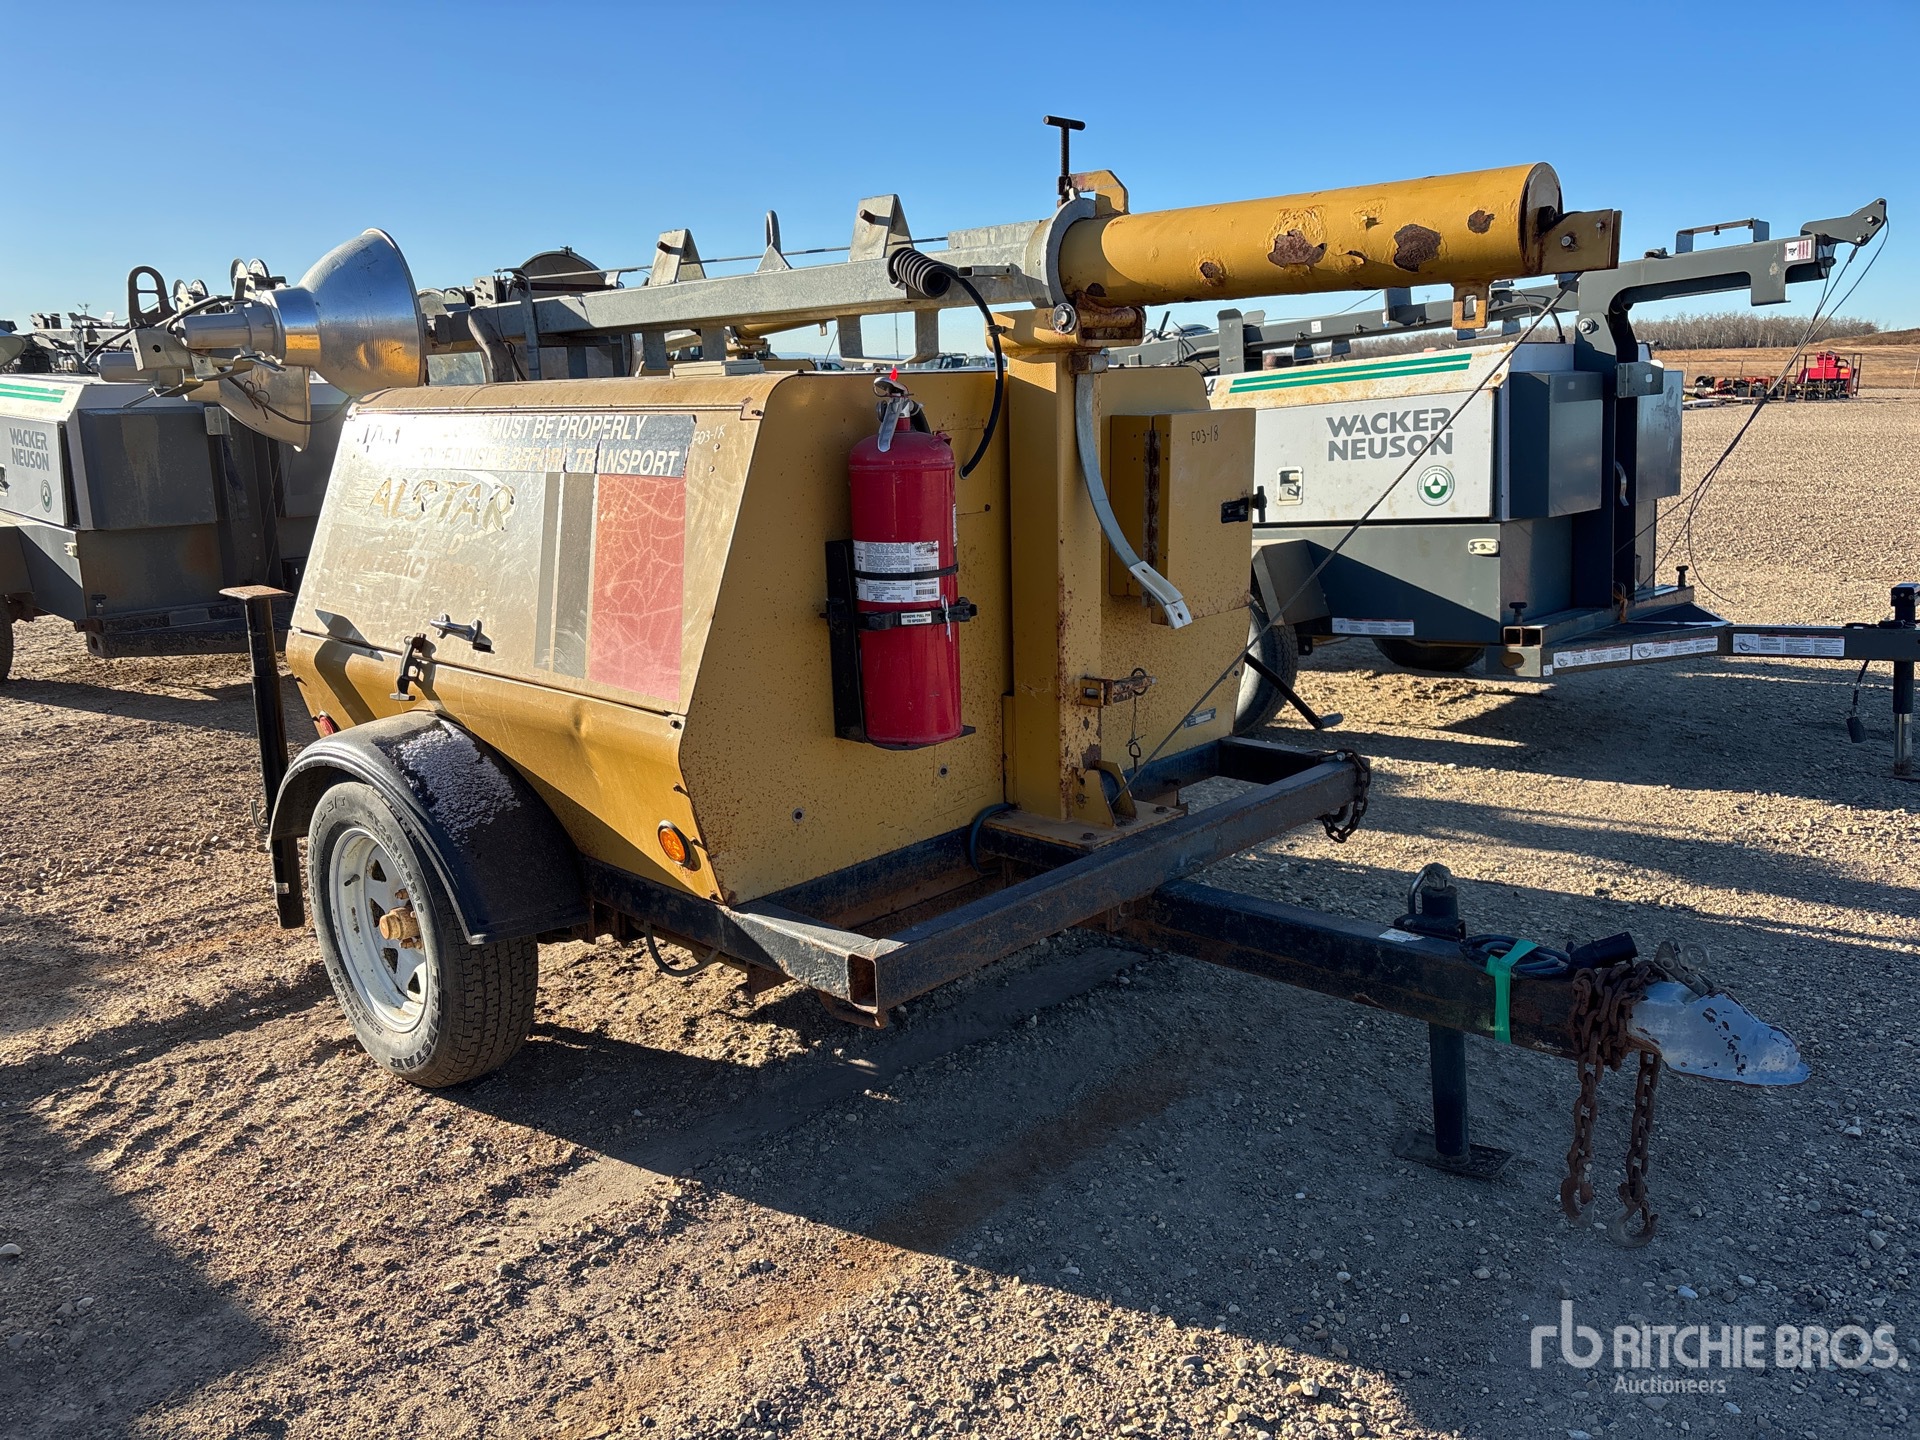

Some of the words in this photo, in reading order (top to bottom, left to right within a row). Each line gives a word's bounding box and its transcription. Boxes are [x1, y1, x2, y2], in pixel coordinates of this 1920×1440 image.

[493, 415, 533, 439] MUST
[533, 415, 557, 440] BE
[557, 415, 648, 441] PROPERLY
[1191, 425, 1219, 446] F03-18
[1326, 408, 1453, 437] WACKER
[9, 427, 48, 451] WACKER
[1328, 432, 1453, 461] NEUSON
[12, 447, 50, 471] NEUSON
[575, 448, 680, 476] TRANSPORT
[365, 477, 516, 532] ALSTAR
